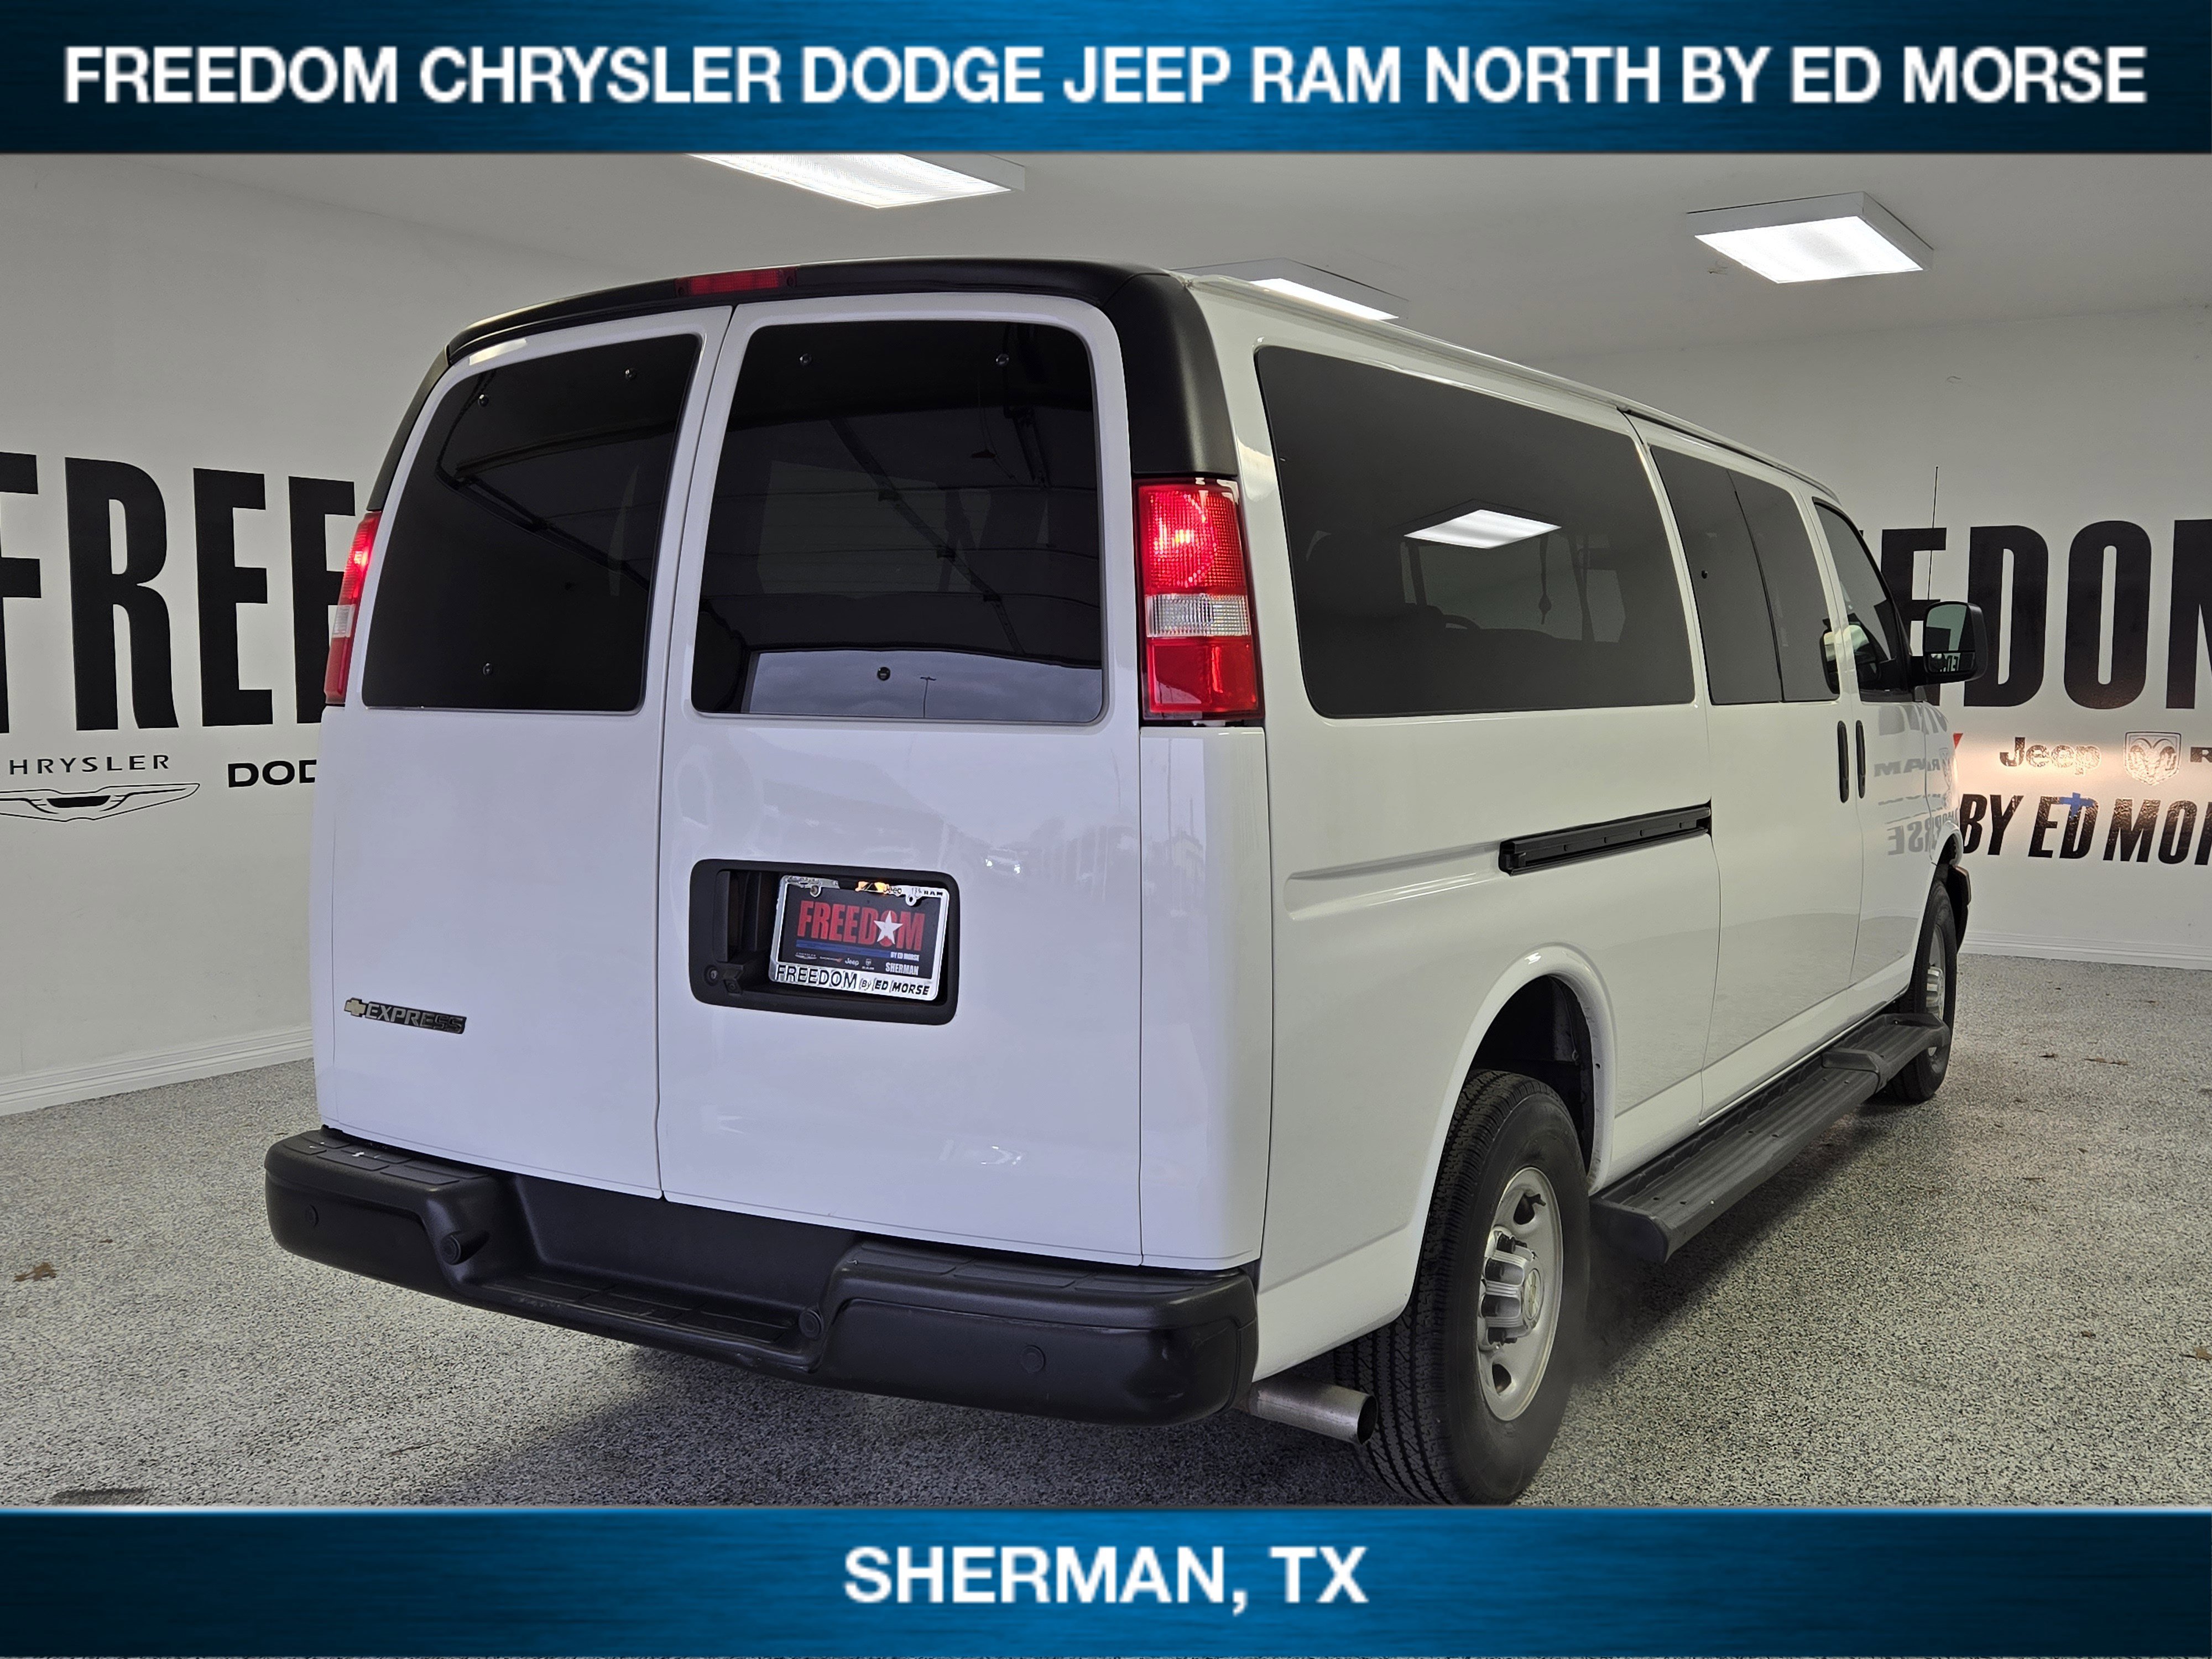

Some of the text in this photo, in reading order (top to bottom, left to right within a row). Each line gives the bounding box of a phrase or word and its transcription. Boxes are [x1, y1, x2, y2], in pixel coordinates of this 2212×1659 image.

[9, 754, 169, 775] HRYSLER
[1999, 737, 2102, 775] Jeep
[1959, 794, 2024, 855] BY
[2028, 795, 2099, 859] ED
[796, 900, 925, 951] FREEDOM
[776, 964, 858, 989] FREEDOM
[874, 979, 889, 990] ED
[891, 982, 930, 995] MORSE
[885, 962, 919, 975] SHERMAN
[366, 1003, 463, 1034] EXPRESS
